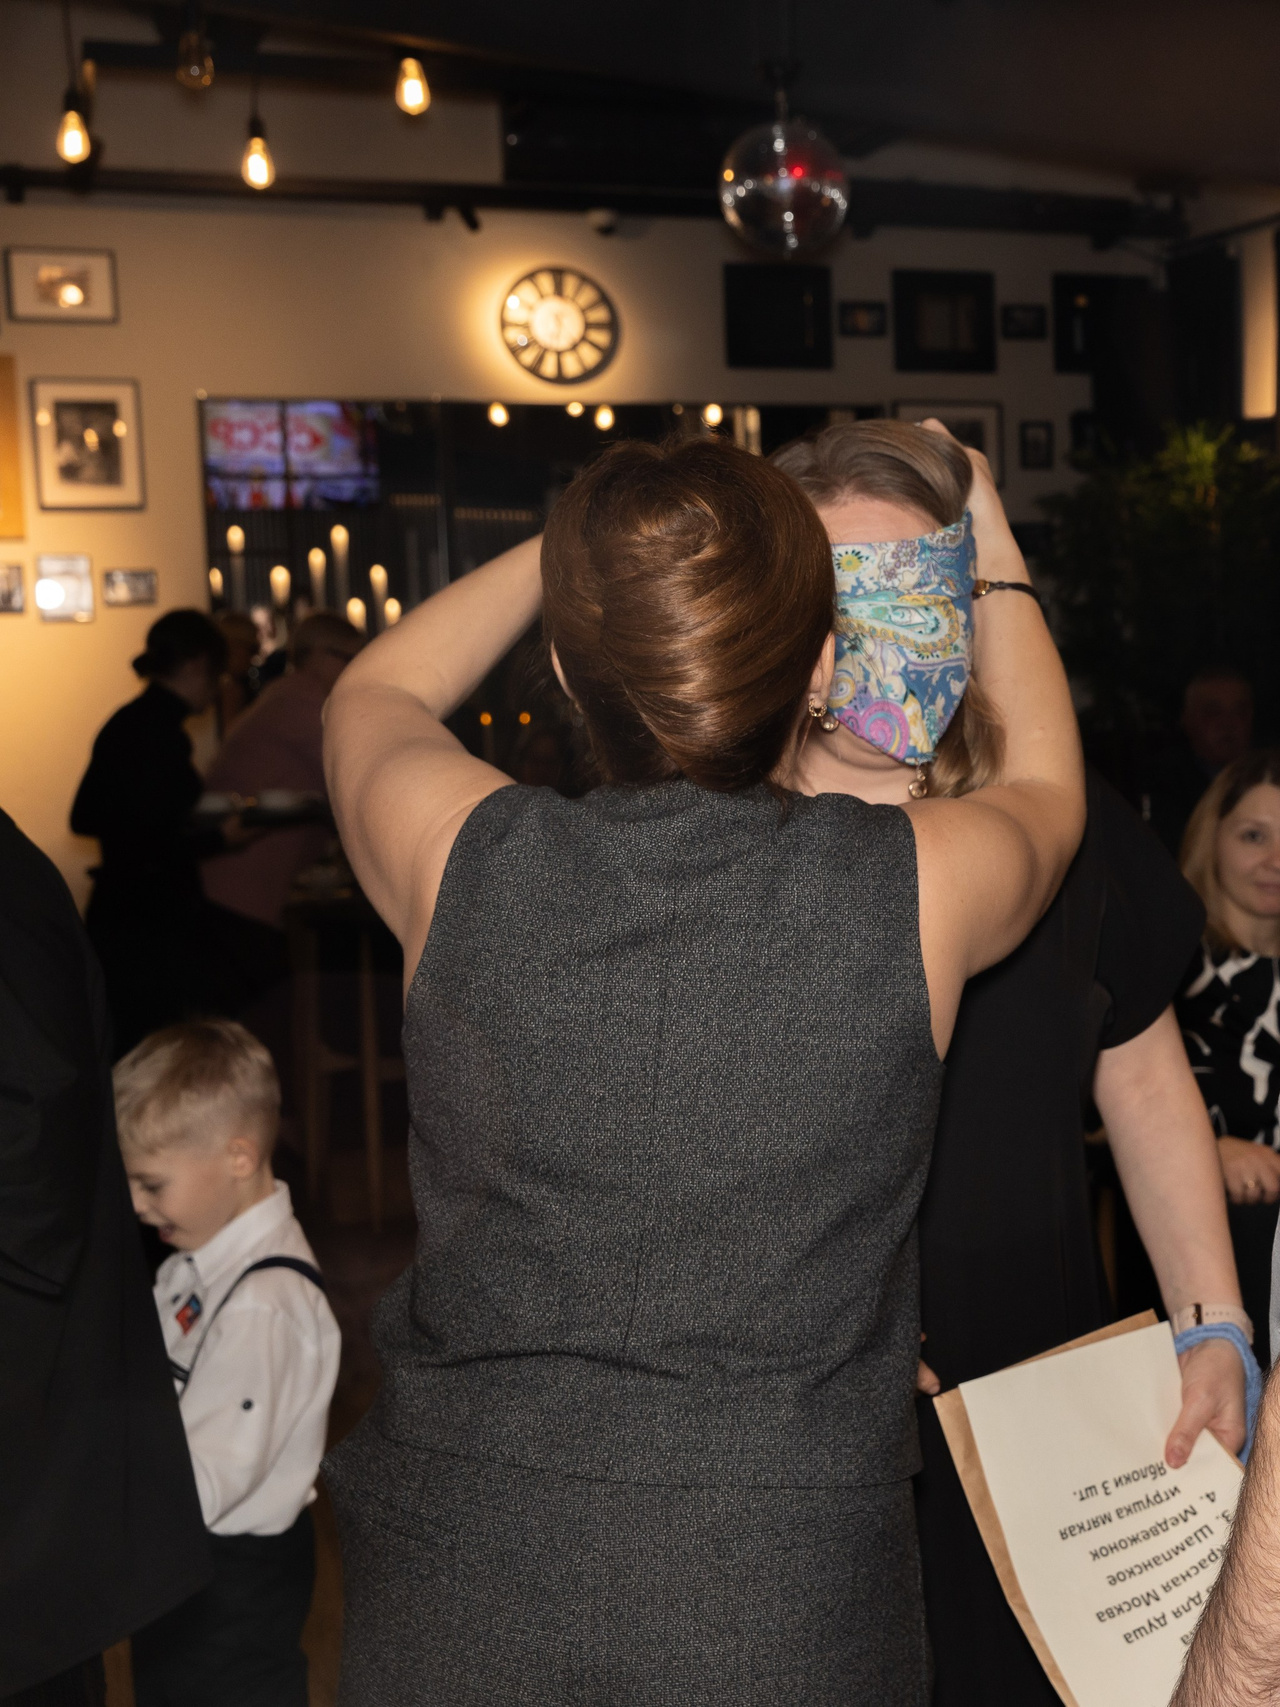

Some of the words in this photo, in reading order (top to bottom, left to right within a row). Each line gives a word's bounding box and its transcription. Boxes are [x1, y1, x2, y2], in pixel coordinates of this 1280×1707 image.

[1101, 1480, 1112, 1496] 3
[1113, 1461, 1167, 1488] Яблоки
[1073, 1485, 1099, 1501] шт.
[1115, 1486, 1181, 1519] игрушка
[1200, 1491, 1216, 1503] 4.
[1059, 1511, 1112, 1541] мягкая
[1089, 1504, 1197, 1561] Медвежонок
[1106, 1524, 1214, 1586] Шампанское
[1096, 1589, 1161, 1623] Москва
[1171, 1591, 1202, 1619] для
[1123, 1612, 1168, 1644] душа
